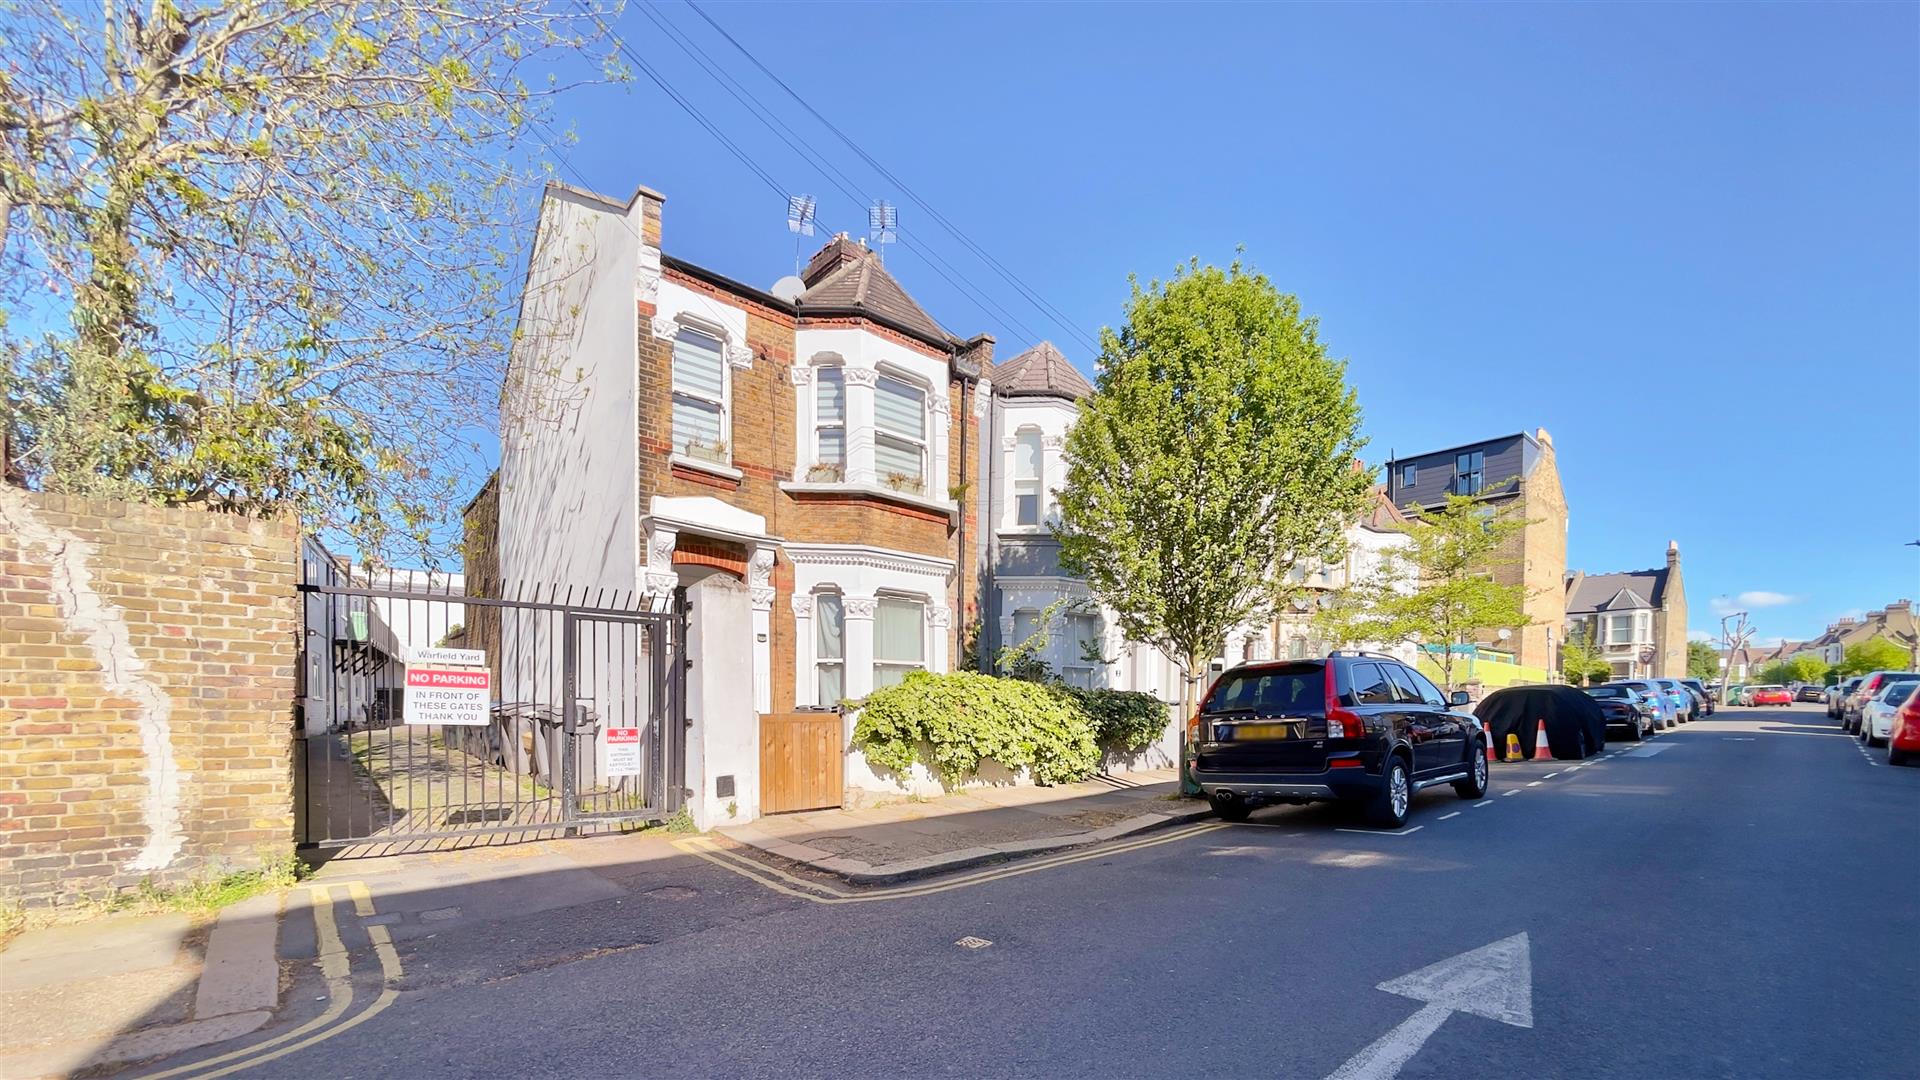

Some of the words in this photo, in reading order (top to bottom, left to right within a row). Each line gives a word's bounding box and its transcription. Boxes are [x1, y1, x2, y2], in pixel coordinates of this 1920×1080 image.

[417, 651, 457, 660] Warfield
[460, 653, 480, 661] Yard
[410, 673, 429, 682] NO
[432, 674, 486, 685] PARKING
[429, 692, 463, 700] FRONT
[413, 701, 447, 709] THESE
[418, 712, 453, 720] THANK
